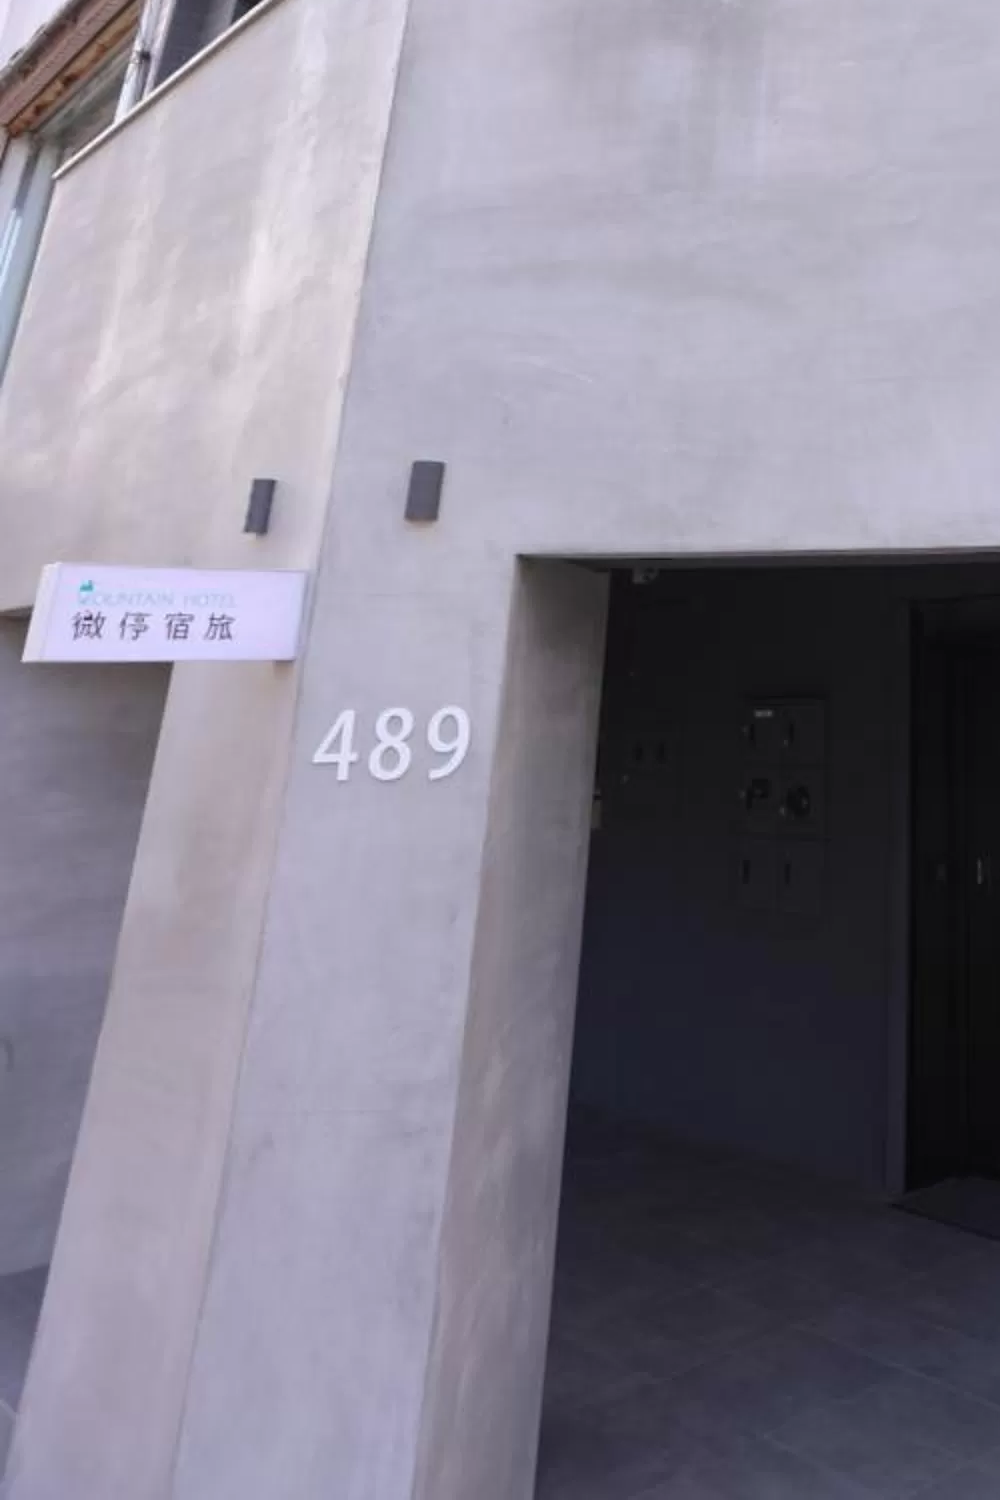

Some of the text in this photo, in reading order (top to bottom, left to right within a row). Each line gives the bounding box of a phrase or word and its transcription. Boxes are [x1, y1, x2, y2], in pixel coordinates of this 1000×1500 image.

[184, 593, 237, 607] HOTEL
[71, 610, 236, 641] 微停宿旅
[312, 705, 470, 781] 489
